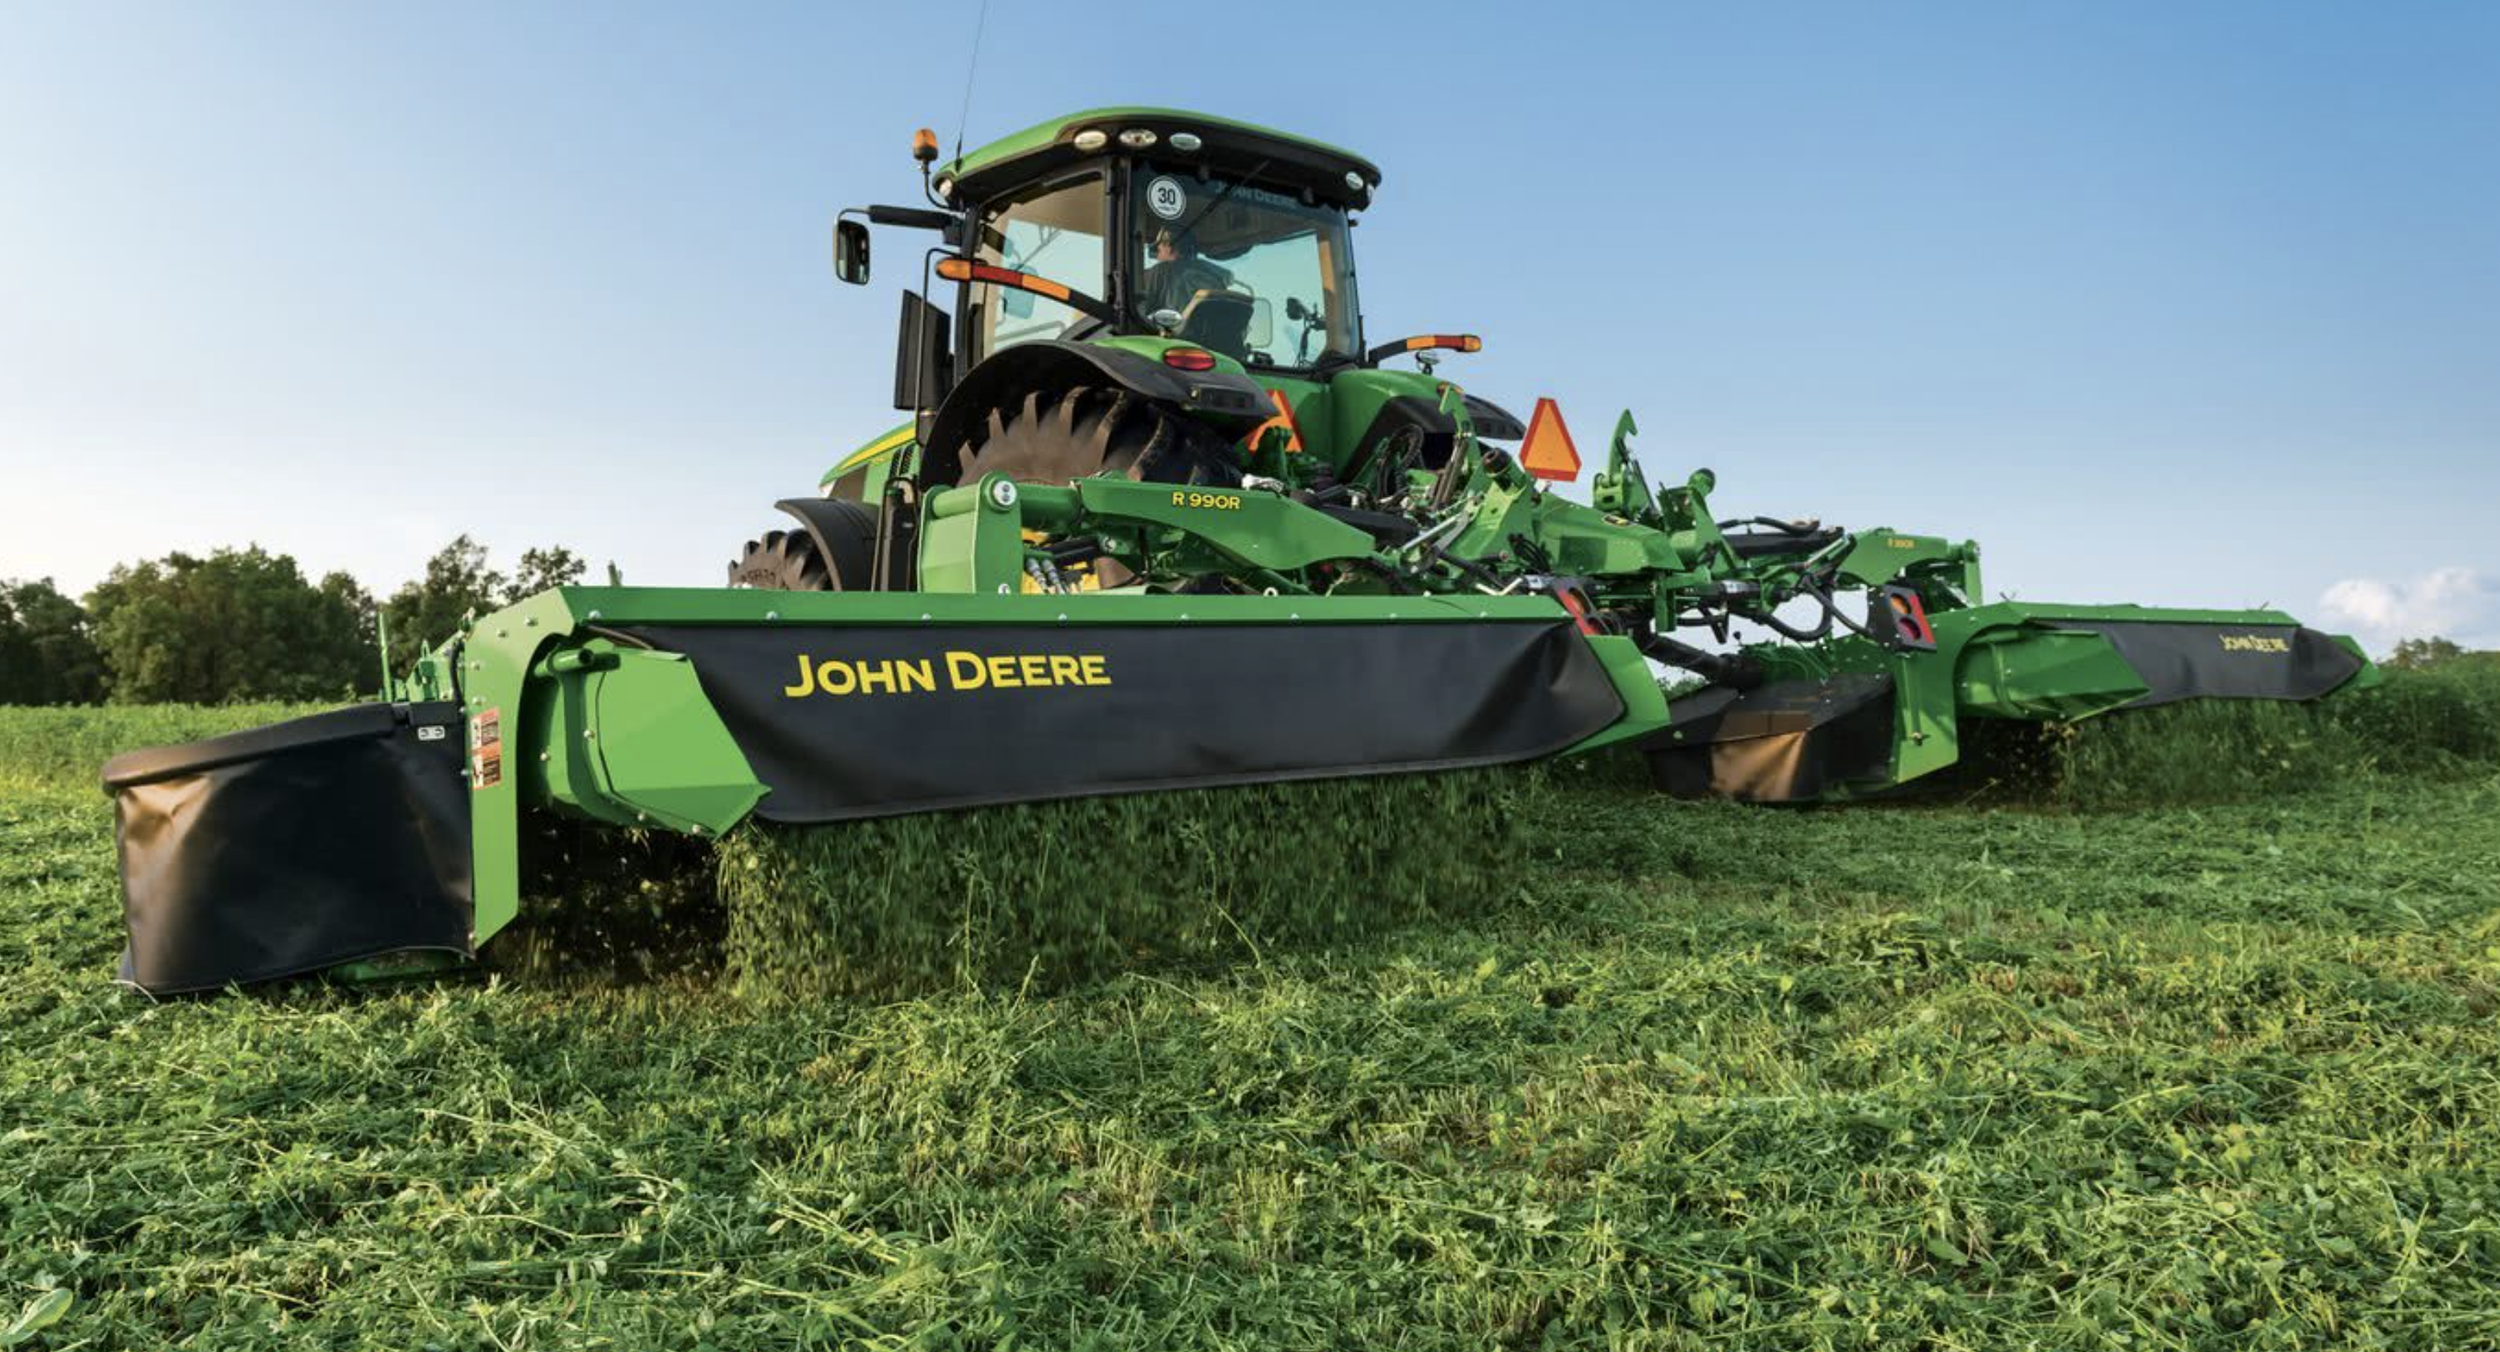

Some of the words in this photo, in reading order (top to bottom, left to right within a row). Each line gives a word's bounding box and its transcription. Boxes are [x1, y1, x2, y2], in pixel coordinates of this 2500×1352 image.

[1157, 186, 1176, 205] 30
[1172, 491, 1185, 506] R
[1189, 493, 1240, 510] 990R
[784, 655, 937, 697] JOHN
[945, 651, 1112, 690] DEERE
